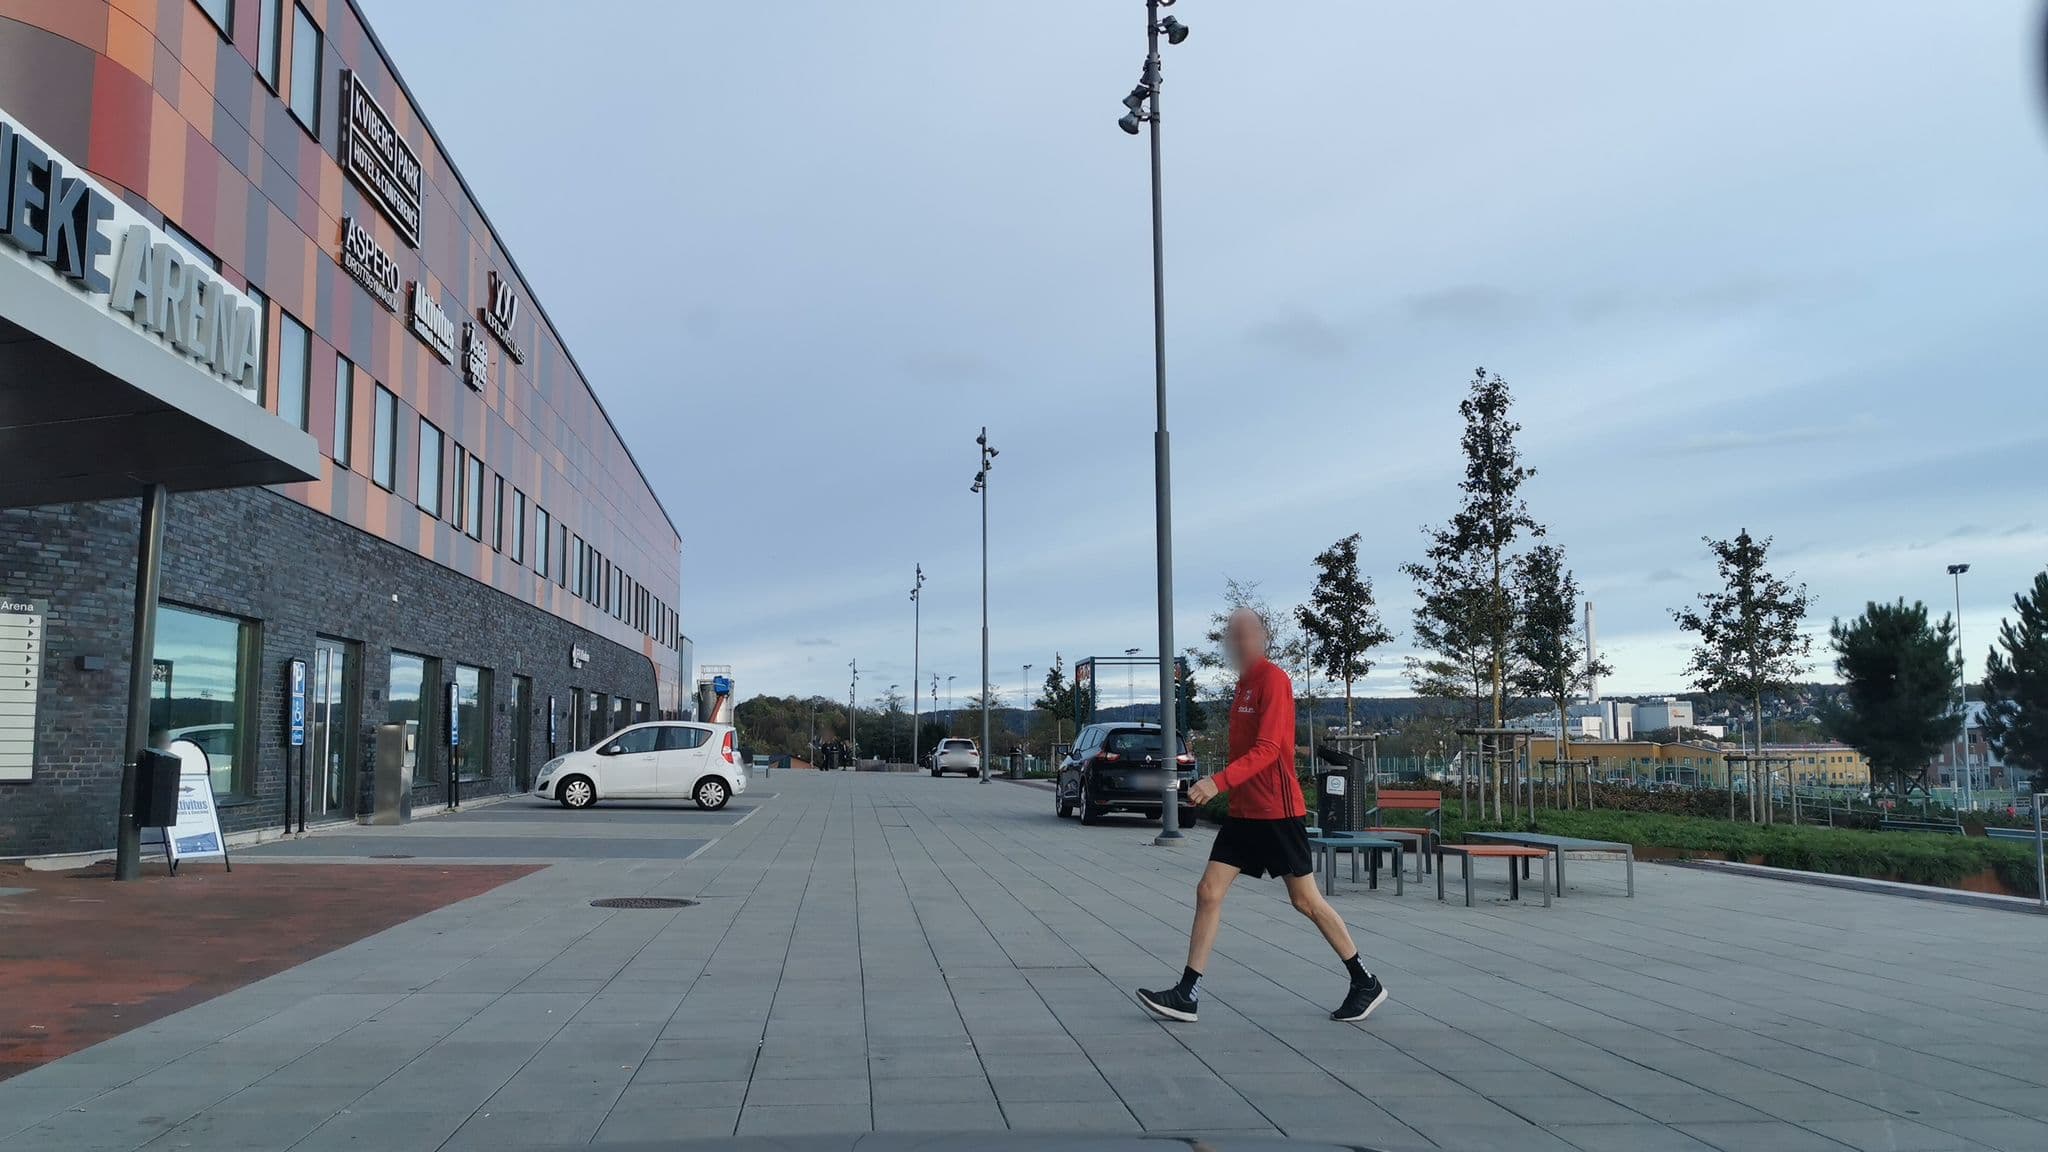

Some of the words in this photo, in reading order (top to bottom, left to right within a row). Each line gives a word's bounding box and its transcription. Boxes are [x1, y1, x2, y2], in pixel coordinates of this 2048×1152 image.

[354, 139, 376, 182] HOTEL
[381, 176, 418, 233] CONFERENCE
[355, 90, 394, 162] KVIBERG
[398, 146, 419, 196] PARK
[346, 216, 400, 294] ASPERO
[108, 224, 258, 390] ARENA
[0, 600, 34, 612] Arena
